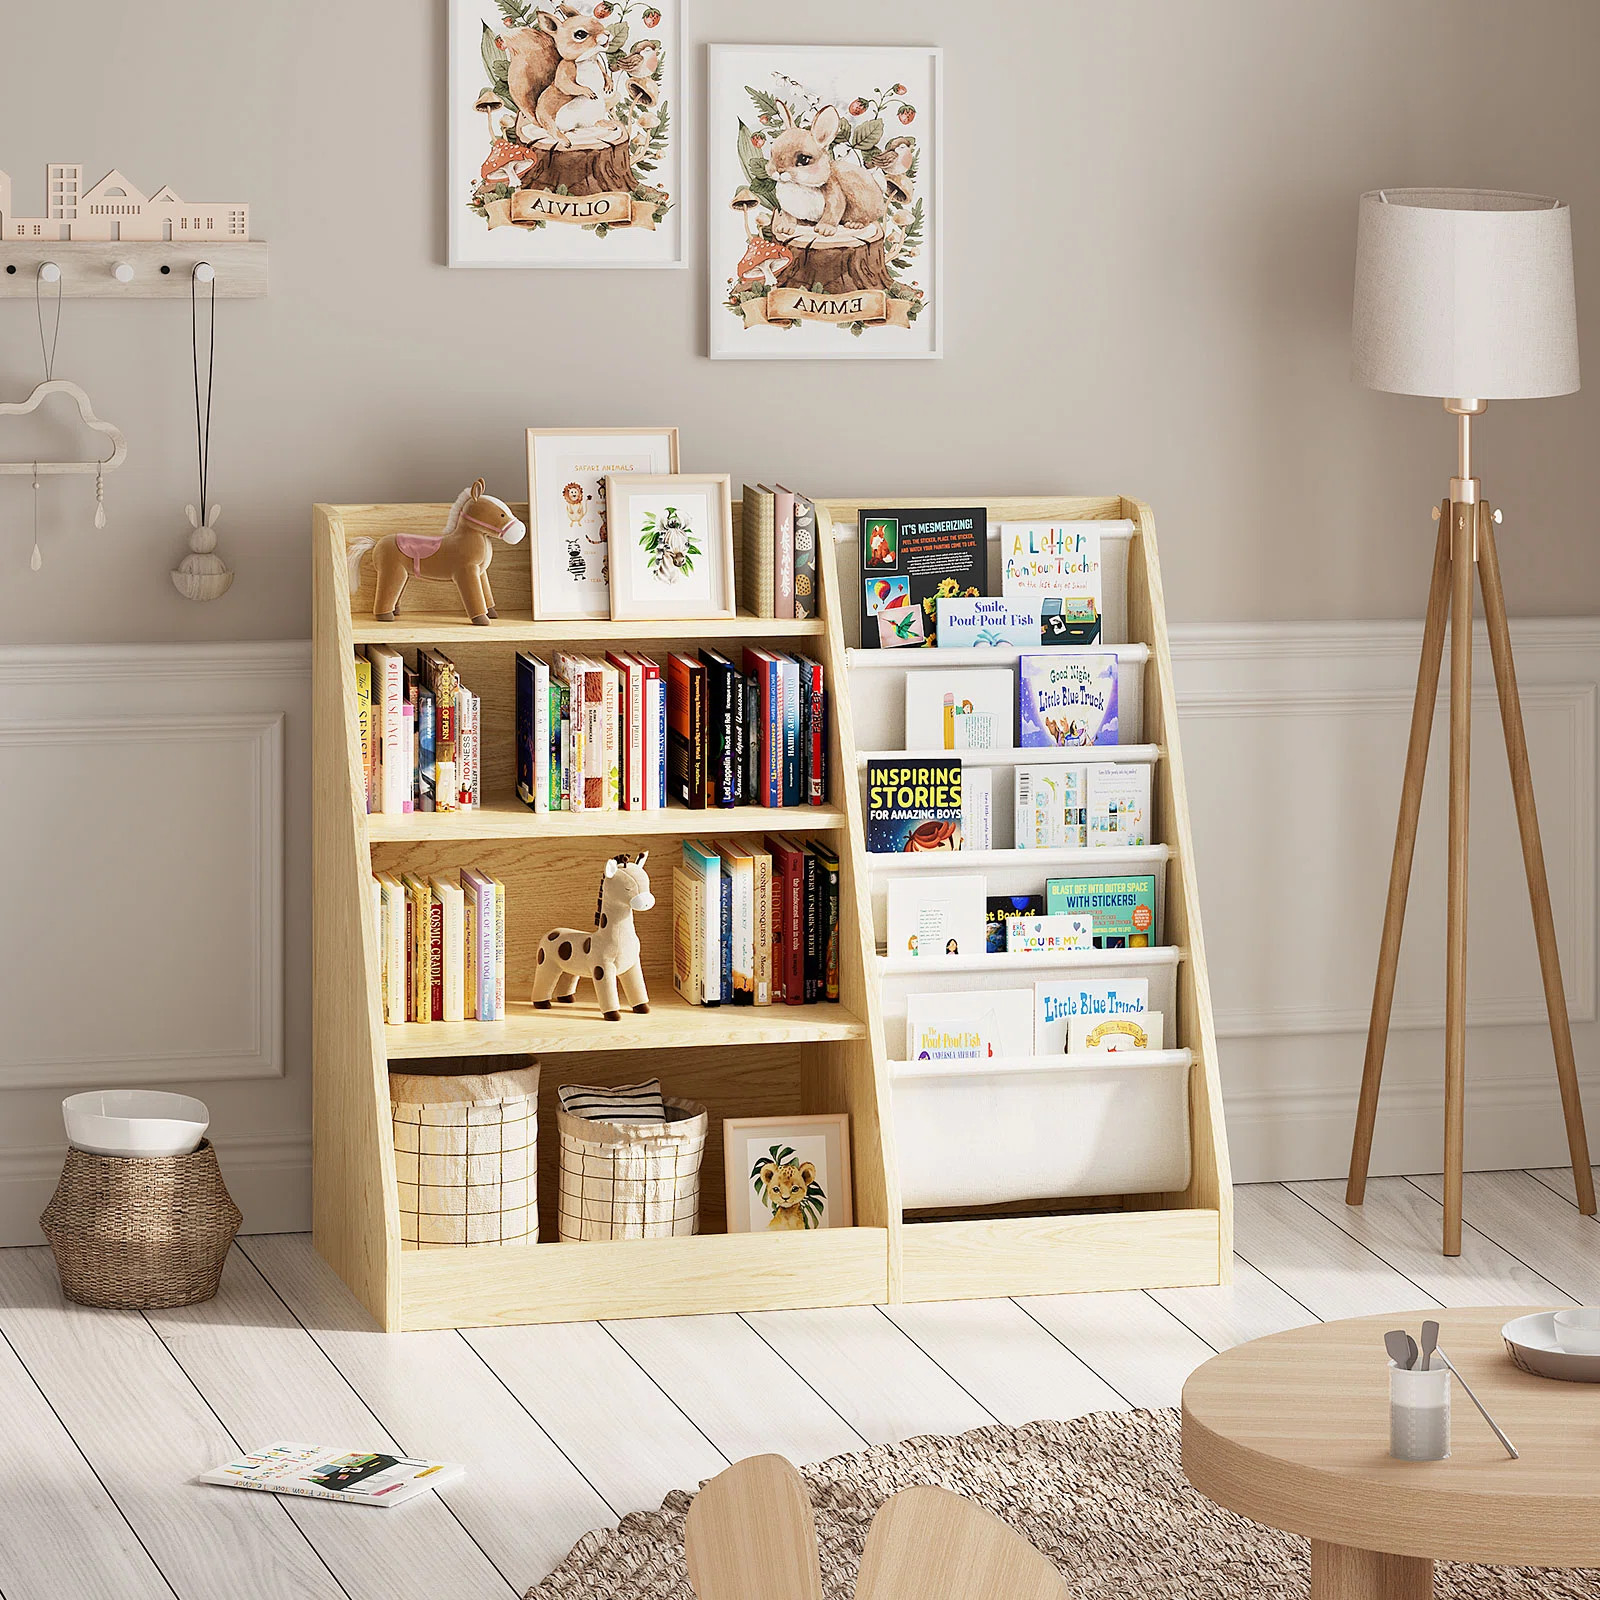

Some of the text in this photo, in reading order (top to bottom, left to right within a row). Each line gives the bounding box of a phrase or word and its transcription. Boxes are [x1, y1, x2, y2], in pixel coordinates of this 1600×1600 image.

[575, 464, 634, 472] SAFARI ANIMALS
[901, 518, 973, 536] IT'S MESMERIZING!
[1013, 528, 1087, 555] A Letter
[1006, 554, 1099, 579] from your Teacher
[974, 600, 1009, 613] Smile,
[949, 613, 1034, 628] Pout-Pout Fish
[1050, 666, 1068, 683] Good
[606, 682, 614, 713] UNITED
[632, 685, 640, 713] PURSUIT
[1038, 685, 1104, 712] Little Blue Truck
[606, 723, 614, 751] PRAYER
[632, 725, 640, 749] PROFIT
[722, 756, 732, 786] Zeppelin
[870, 768, 961, 786] INSPIRING
[723, 786, 731, 800] Led
[870, 786, 961, 808] STORIES
[870, 809, 961, 820] FOR AMAZING BOYS
[792, 878, 800, 887] the
[1052, 882, 1148, 895] BLAST OFF INTO OUTER SPACE
[772, 881, 782, 930] CHOICES
[792, 887, 800, 918] handsomest
[808, 894, 815, 903] AT
[1067, 894, 1136, 908] WITH STICKERS!
[997, 909, 1021, 920] Book
[430, 908, 441, 945] COSMIC
[483, 919, 490, 930] OF
[792, 918, 800, 930] man
[792, 938, 800, 950] cuba
[1024, 937, 1078, 946] YOU'RE MY
[430, 948, 441, 986] CRADLE
[1044, 997, 1077, 1022] Little
[1080, 992, 1105, 1015] Blue
